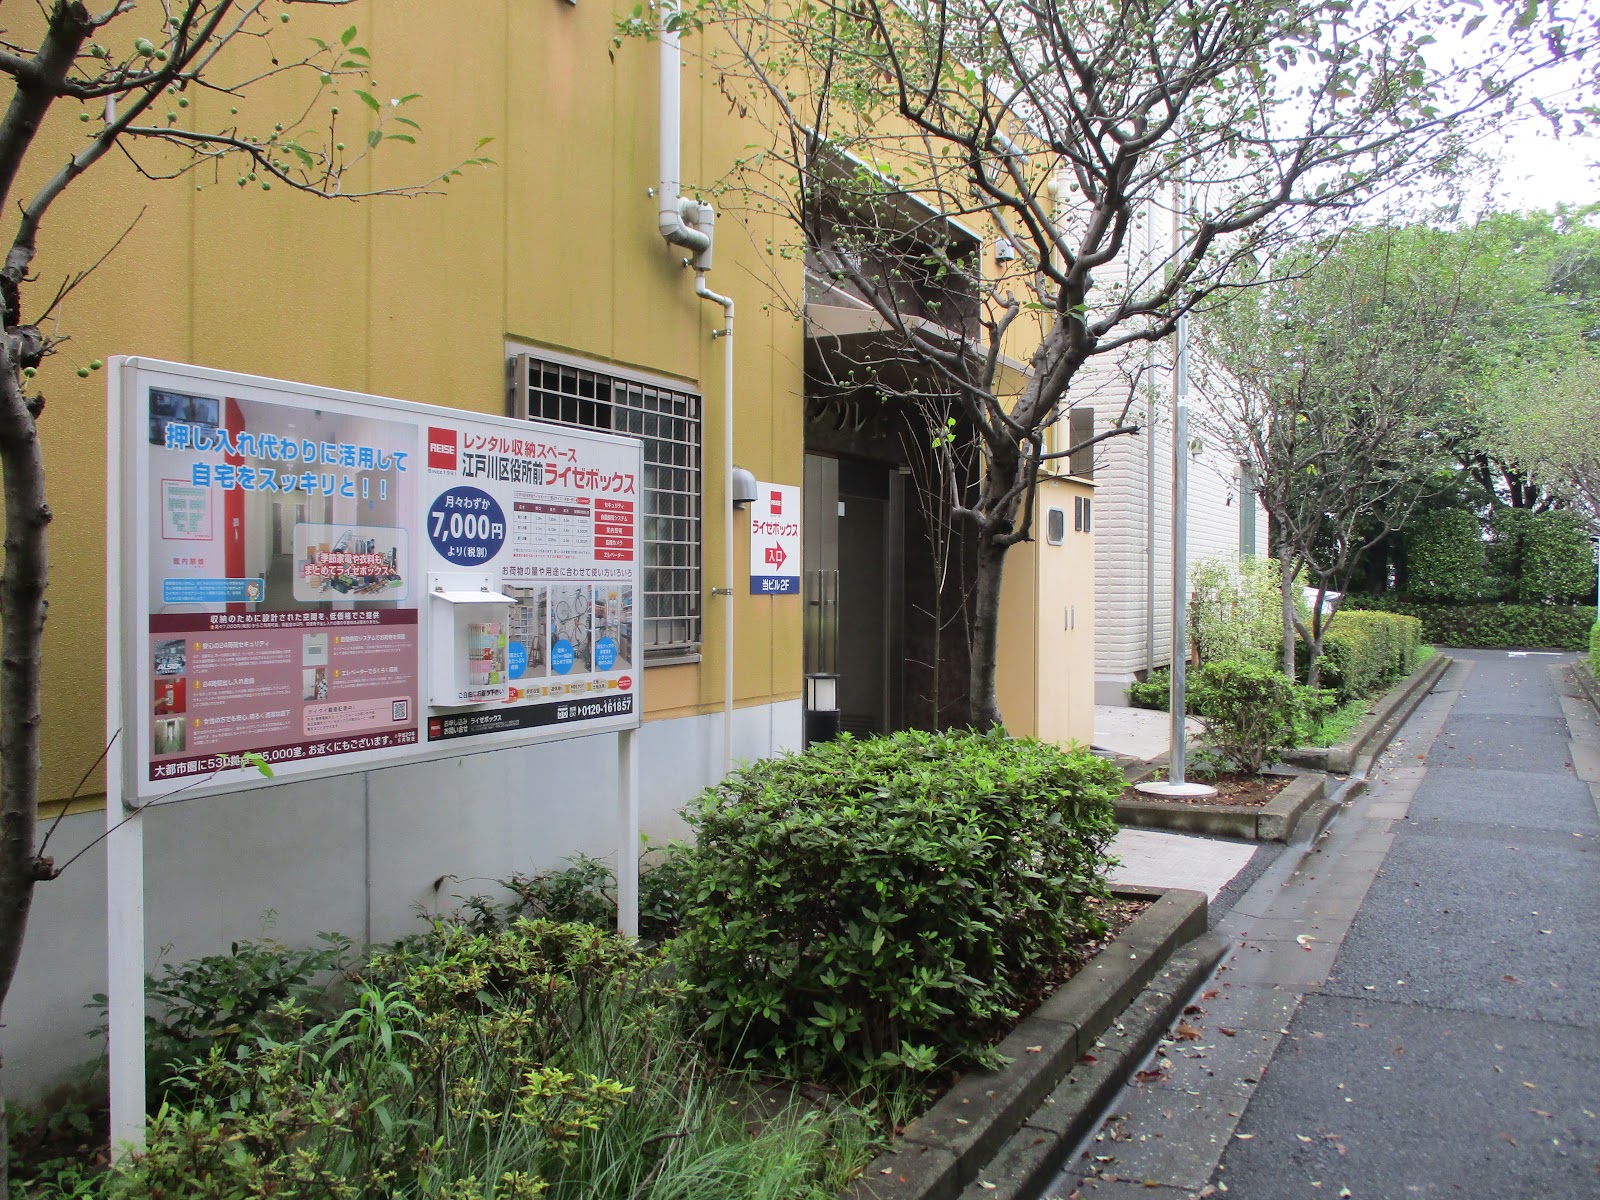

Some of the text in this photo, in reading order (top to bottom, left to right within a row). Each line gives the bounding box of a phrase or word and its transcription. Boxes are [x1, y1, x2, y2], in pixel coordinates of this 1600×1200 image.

[165, 422, 408, 472] 押し入れ代わりに活用して
[430, 443, 455, 455] REISE
[463, 433, 577, 463] レンタル収納スペース
[444, 496, 491, 510] 月々わずか
[432, 512, 503, 542] 7,000円
[752, 520, 799, 537] ライゼボックス
[447, 545, 488, 558] より(税別)
[768, 550, 783, 562] 入口
[304, 565, 398, 576] まとめてライゼボックスへ
[502, 566, 633, 579] お荷物の量や用途に合わせて使い方いろいろ
[761, 578, 790, 591] 当ビル2F
[582, 700, 632, 716] 0120-161857
[470, 714, 502, 725] ライゼボックス
